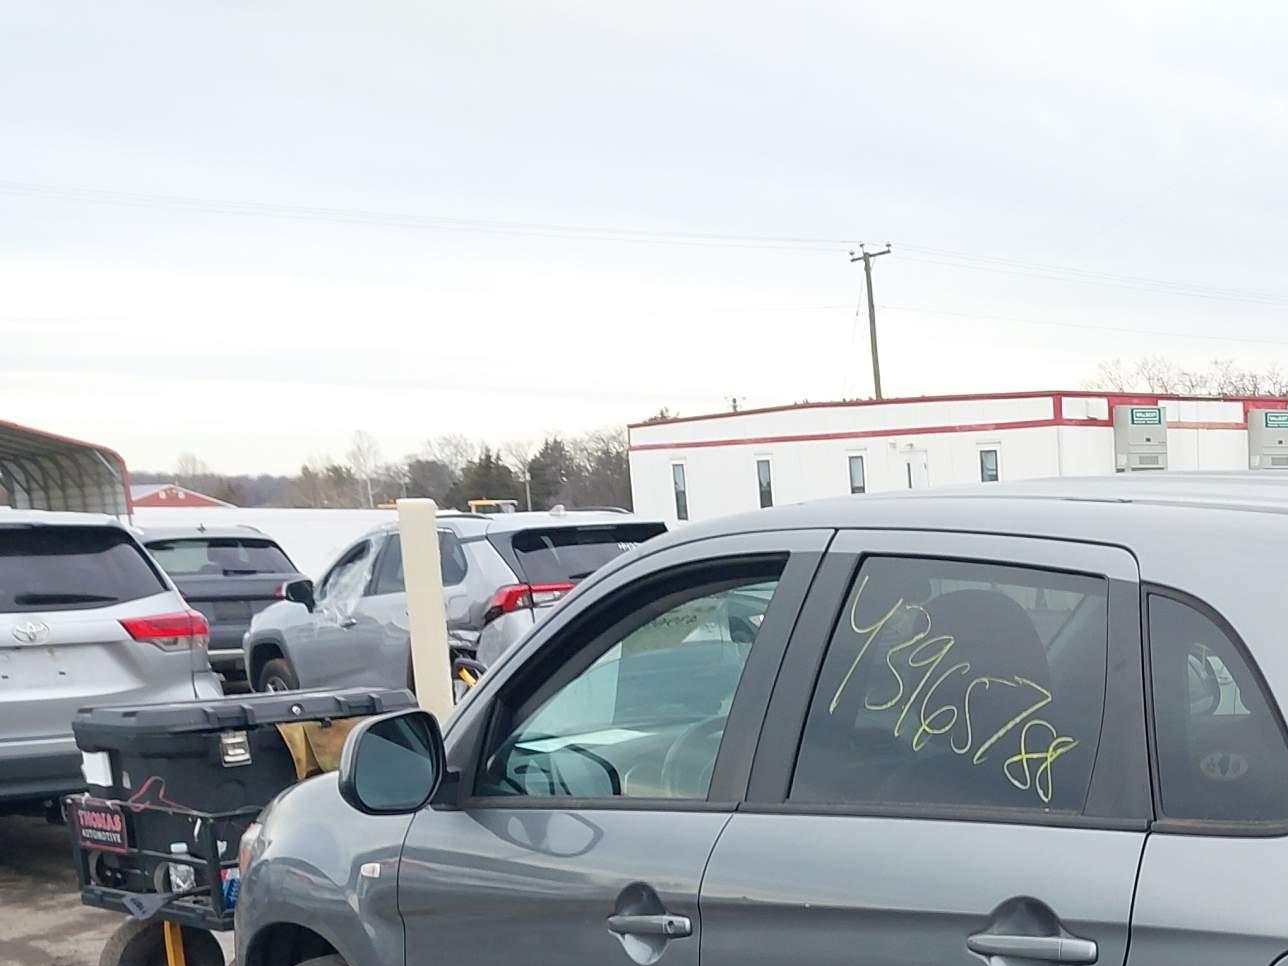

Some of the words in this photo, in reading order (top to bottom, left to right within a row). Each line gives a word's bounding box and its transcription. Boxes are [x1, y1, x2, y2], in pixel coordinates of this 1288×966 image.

[829, 575, 1079, 803] 43965788
[78, 809, 122, 832] THOMAS
[81, 828, 122, 844] AUTOMOTIVE
